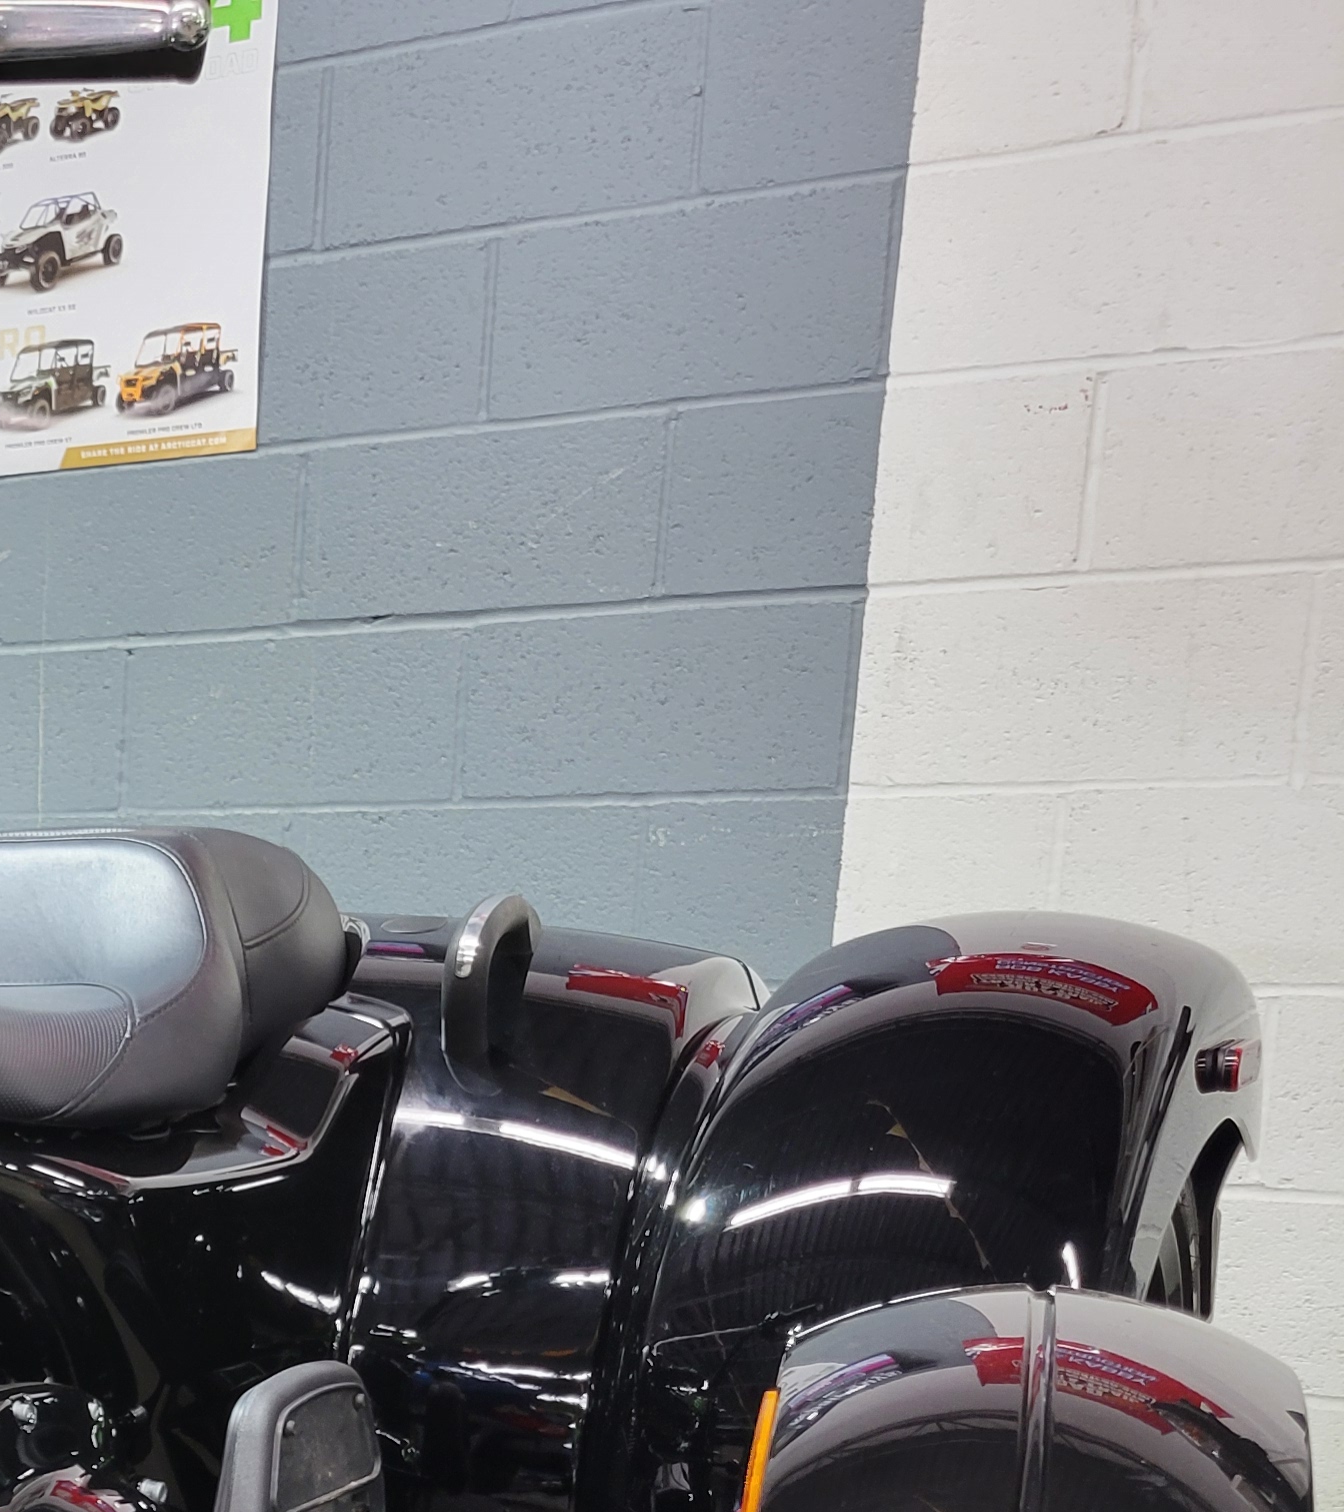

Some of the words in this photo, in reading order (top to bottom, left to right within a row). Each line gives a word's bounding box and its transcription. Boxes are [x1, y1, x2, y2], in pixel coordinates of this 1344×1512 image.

[109, 446, 125, 455] THE
[127, 445, 147, 454] RIDE
[148, 443, 160, 451] AT
[161, 436, 227, 450] ARCTICCAT.COM
